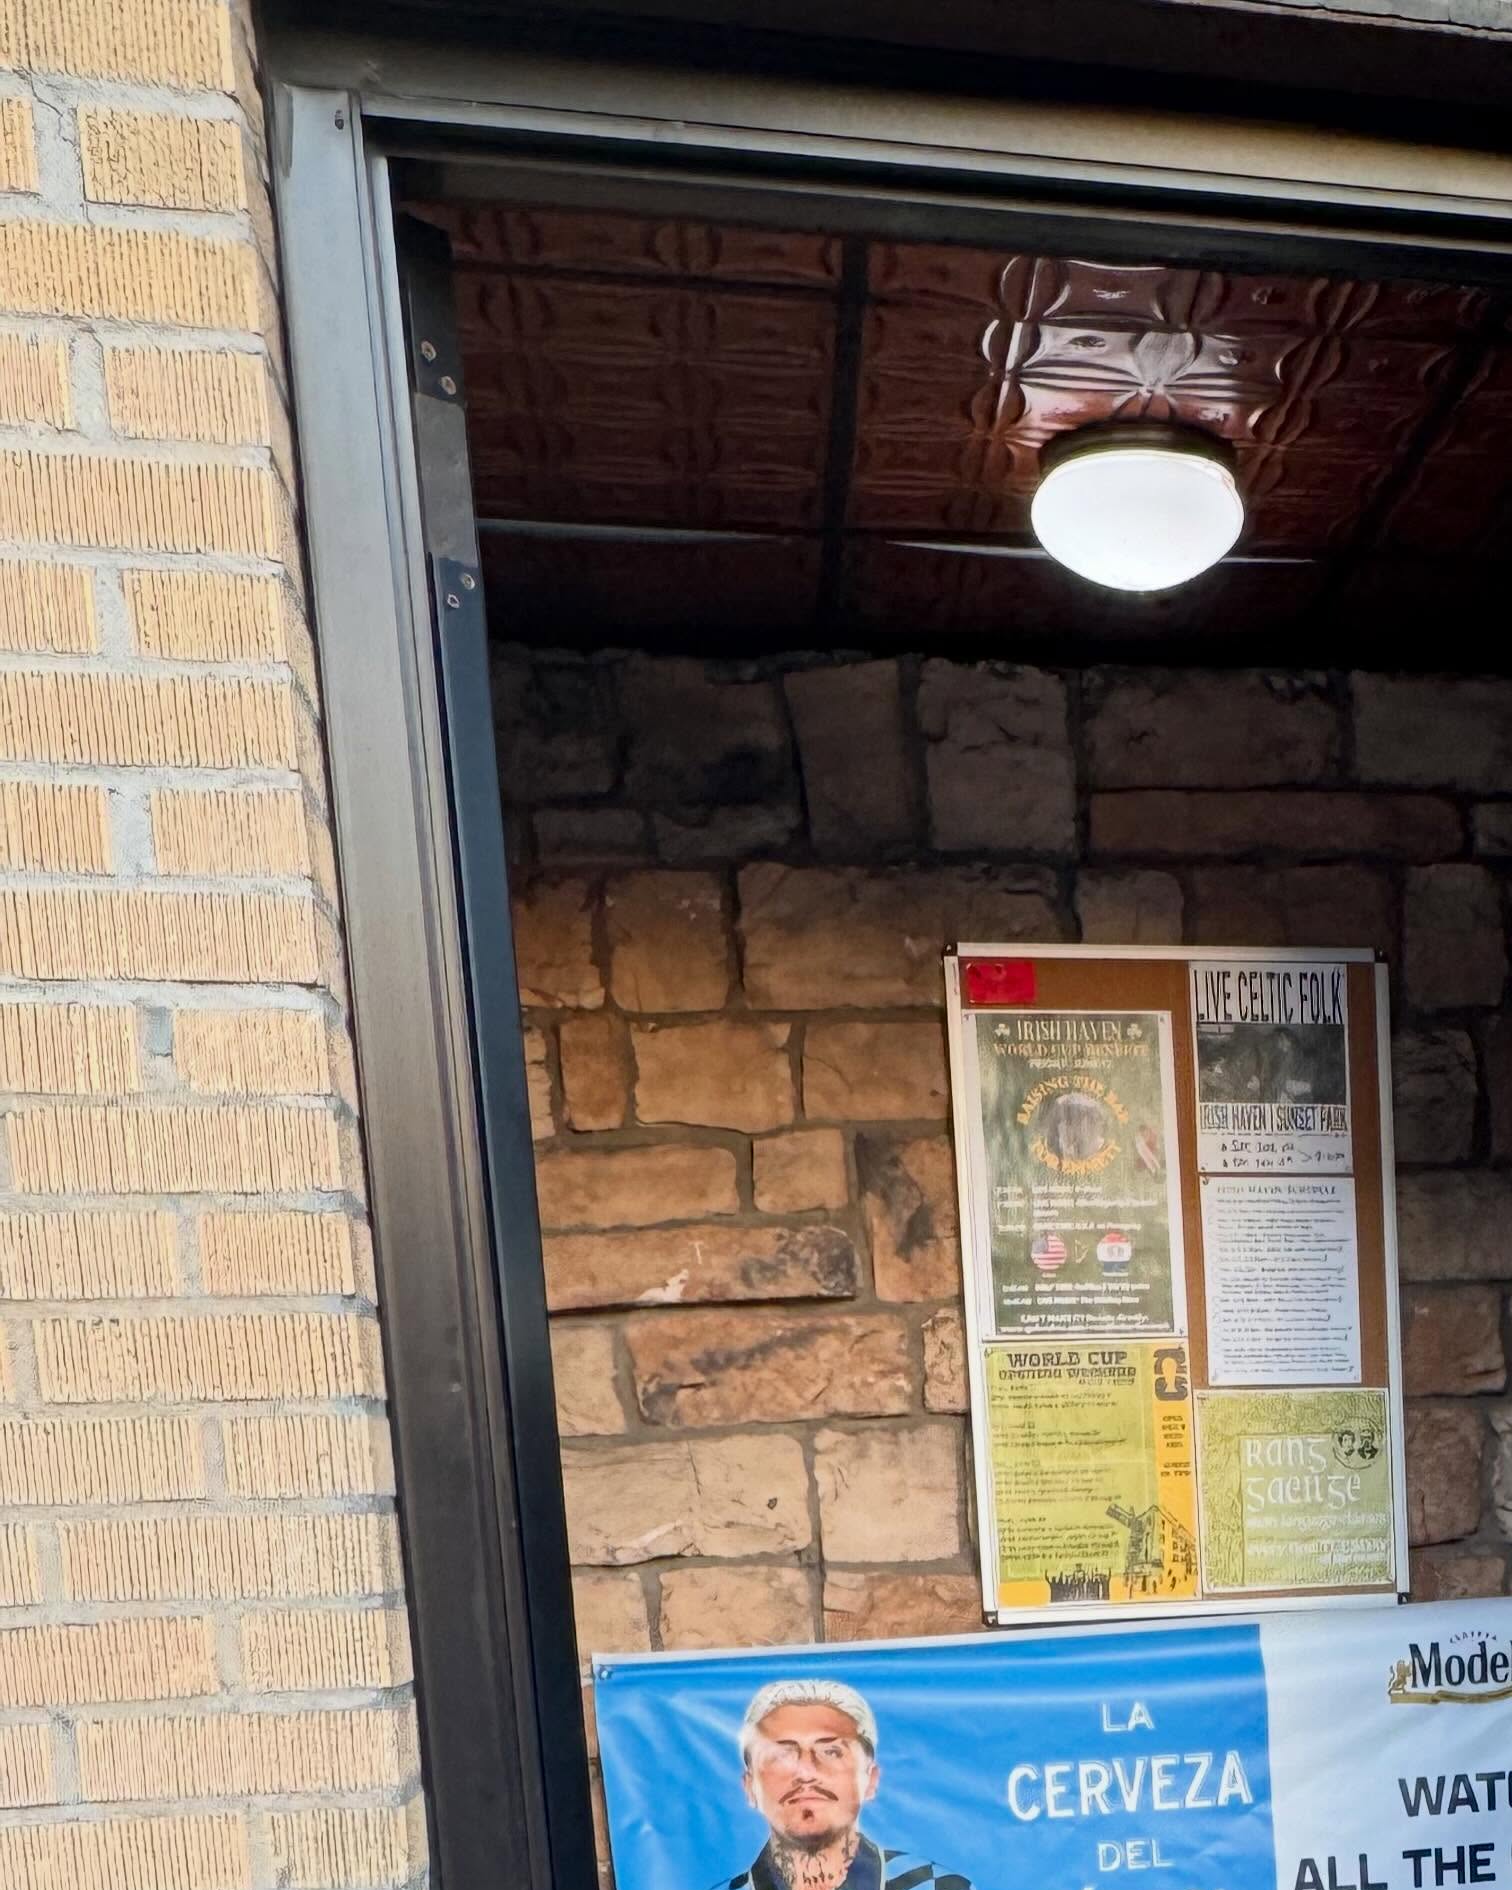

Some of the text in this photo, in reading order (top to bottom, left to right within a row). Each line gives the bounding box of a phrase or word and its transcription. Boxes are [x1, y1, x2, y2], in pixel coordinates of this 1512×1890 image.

[1194, 968, 1344, 1024] LIVE CELTIC FOLK
[1017, 1019, 1122, 1042] IRISH HAVEN
[1200, 1105, 1229, 1130] IRISH
[1232, 1106, 1267, 1131] HAVEN
[1276, 1106, 1317, 1132] SUNSET
[1320, 1105, 1348, 1131] PARK
[1007, 1351, 1129, 1368] WORLD CUP
[1102, 1702, 1155, 1733] LA
[1007, 1750, 1254, 1822] CERVEZA
[1097, 1839, 1175, 1873] DEL
[1402, 1843, 1496, 1888] THE
